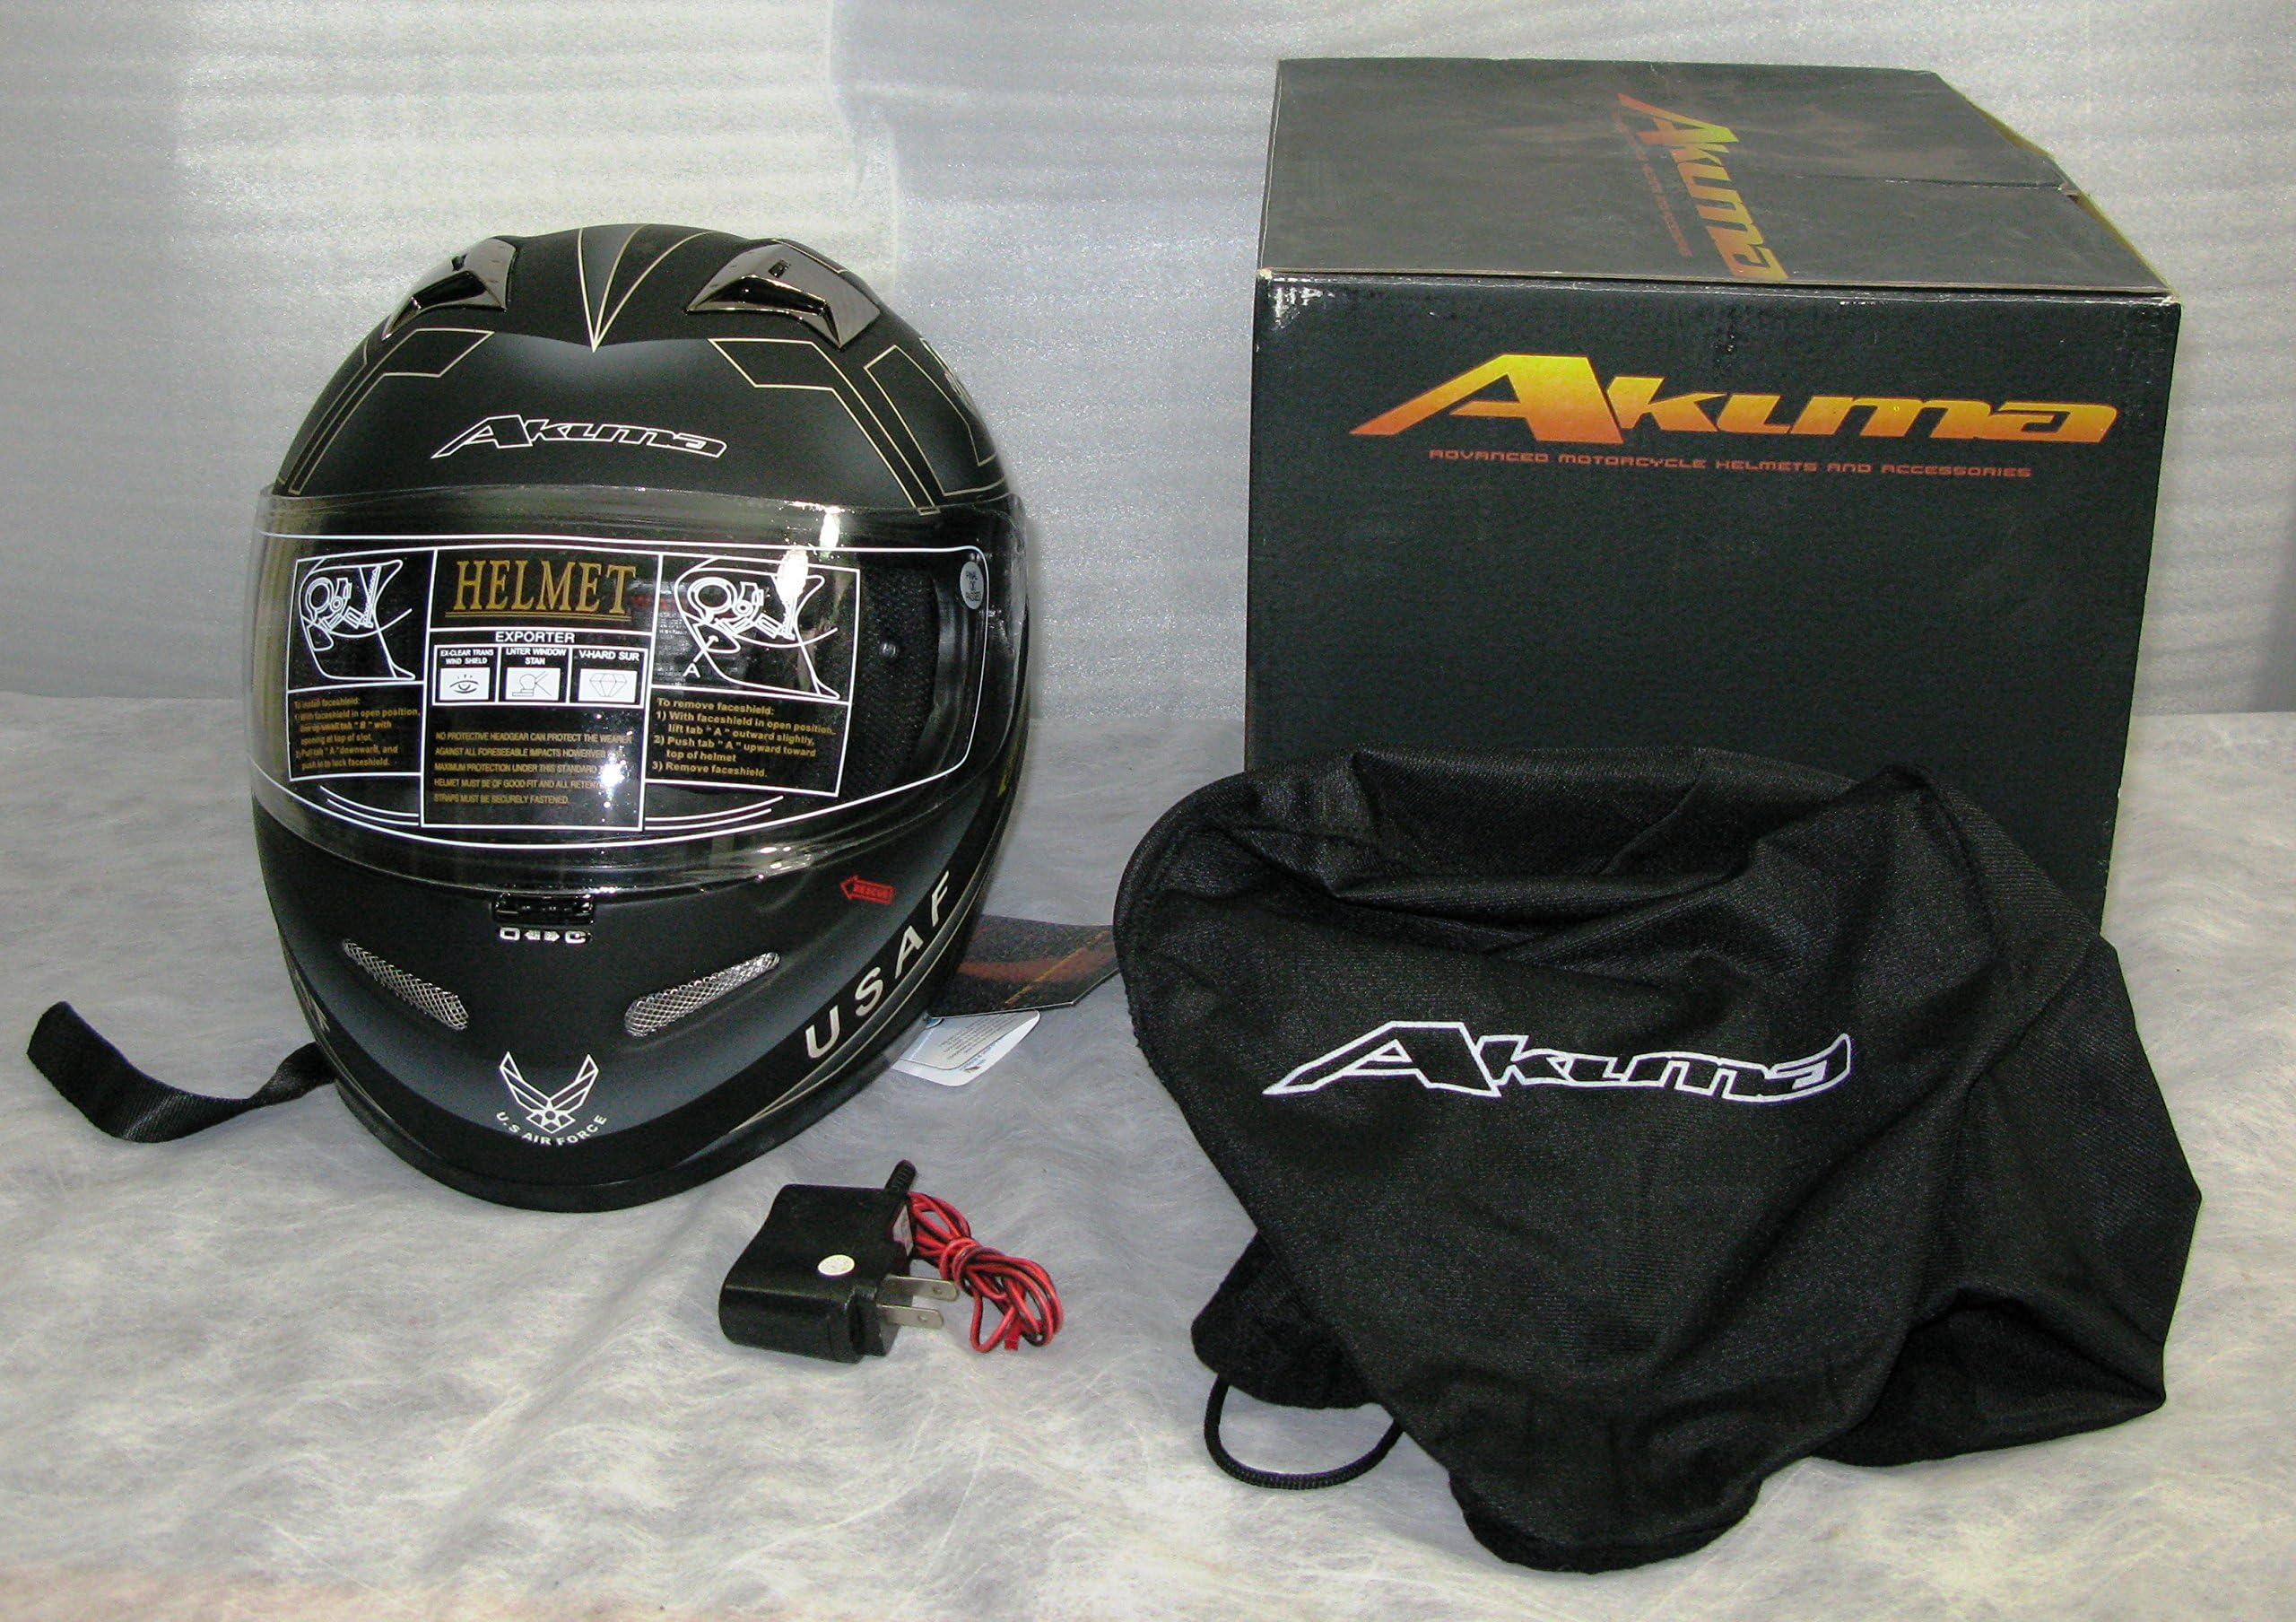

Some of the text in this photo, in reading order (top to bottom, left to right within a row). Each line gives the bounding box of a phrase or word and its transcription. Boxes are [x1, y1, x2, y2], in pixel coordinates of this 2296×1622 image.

[1617, 92, 1788, 282] Akuma
[1348, 353, 2118, 444] Akuma
[431, 414, 727, 459] Akuma
[1428, 449, 2031, 478] ADVANCED MOTORCYCLE HELMETS AND ACCESSORIES
[453, 560, 636, 615] HELMET
[495, 631, 576, 643] EXPORTER
[533, 649, 567, 657] WINDOW
[579, 650, 640, 662] V-HARD SUR
[683, 663, 700, 678] A
[361, 709, 381, 719] open
[657, 697, 774, 716] To remove faceshield:
[668, 711, 695, 721] With
[697, 713, 752, 727] faceshield
[754, 718, 764, 728] in
[767, 720, 791, 730] open
[435, 731, 447, 740] NO
[448, 731, 489, 740] PROTECTIVE
[490, 731, 529, 741] HEADGEAR
[530, 732, 546, 741] CAN
[547, 732, 583, 742] PROTECT
[584, 733, 599, 743] THE
[668, 723, 684, 734] lift
[686, 725, 704, 735] tab
[732, 729, 775, 741] outward
[435, 747, 465, 756] AGAINST
[465, 747, 476, 756] ALL
[529, 748, 562, 758] IMPACTS
[667, 736, 696, 747] Push
[697, 738, 715, 748] tab
[744, 743, 781, 754] upward
[783, 746, 817, 757] toward
[666, 749, 736, 763] top of helmet
[466, 763, 511, 772] PROTECTION
[512, 763, 538, 772] UNDER
[539, 763, 556, 773] THIS
[557, 764, 598, 773] STANDARD
[665, 761, 709, 773] Remove
[711, 763, 768, 778] faceshield.
[434, 778, 459, 788] HELMET
[461, 778, 481, 788] MUST
[482, 779, 491, 788] BE
[492, 779, 502, 788] OF
[503, 779, 526, 788] GOOD
[526, 779, 538, 788] FIT
[539, 780, 554, 789] AND
[555, 780, 568, 789] ALL
[460, 793, 480, 803] MUST
[481, 794, 491, 803] BE
[491, 794, 528, 804] SECURELY
[805, 871, 949, 1059] USAF
[1262, 1021, 1851, 1103] Akuma
[522, 1131, 552, 1146] AIR
[556, 1114, 607, 1146] FORCE
